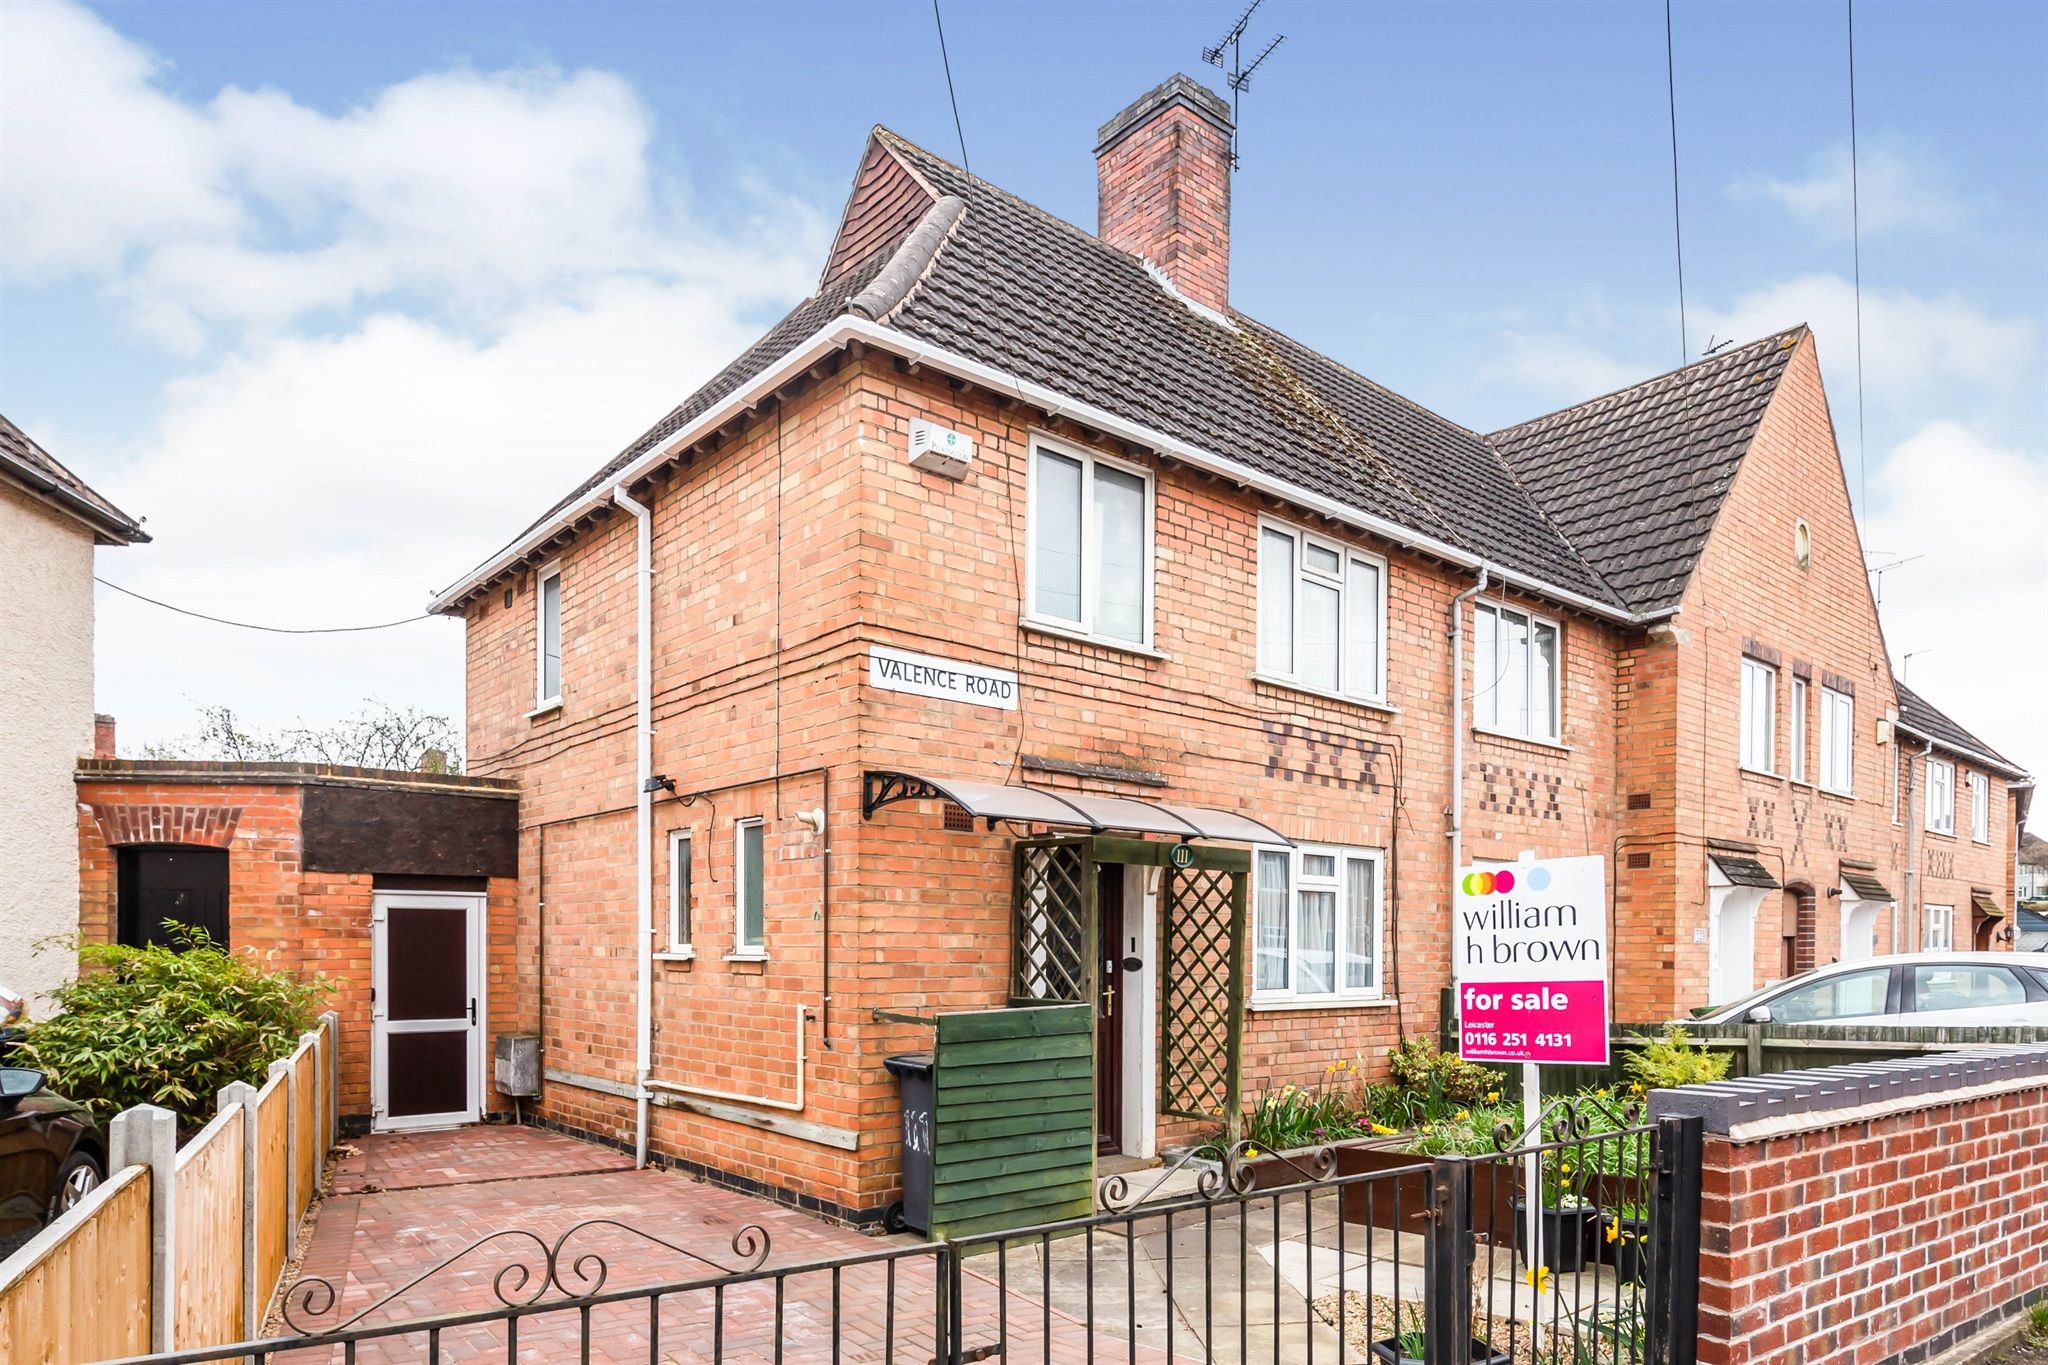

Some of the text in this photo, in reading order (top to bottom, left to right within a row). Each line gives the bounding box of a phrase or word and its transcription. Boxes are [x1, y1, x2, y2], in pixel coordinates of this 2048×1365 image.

[879, 658, 1011, 699] VALENCE ROAD
[1463, 900, 1577, 931] william
[1467, 934, 1600, 964] h brown
[1464, 987, 1569, 1011] for sale
[1464, 1020, 1495, 1029] Leicester
[1465, 1032, 1572, 1047] 0116 251 4131
[1465, 1048, 1525, 1057] williamhbrown.co.uk
